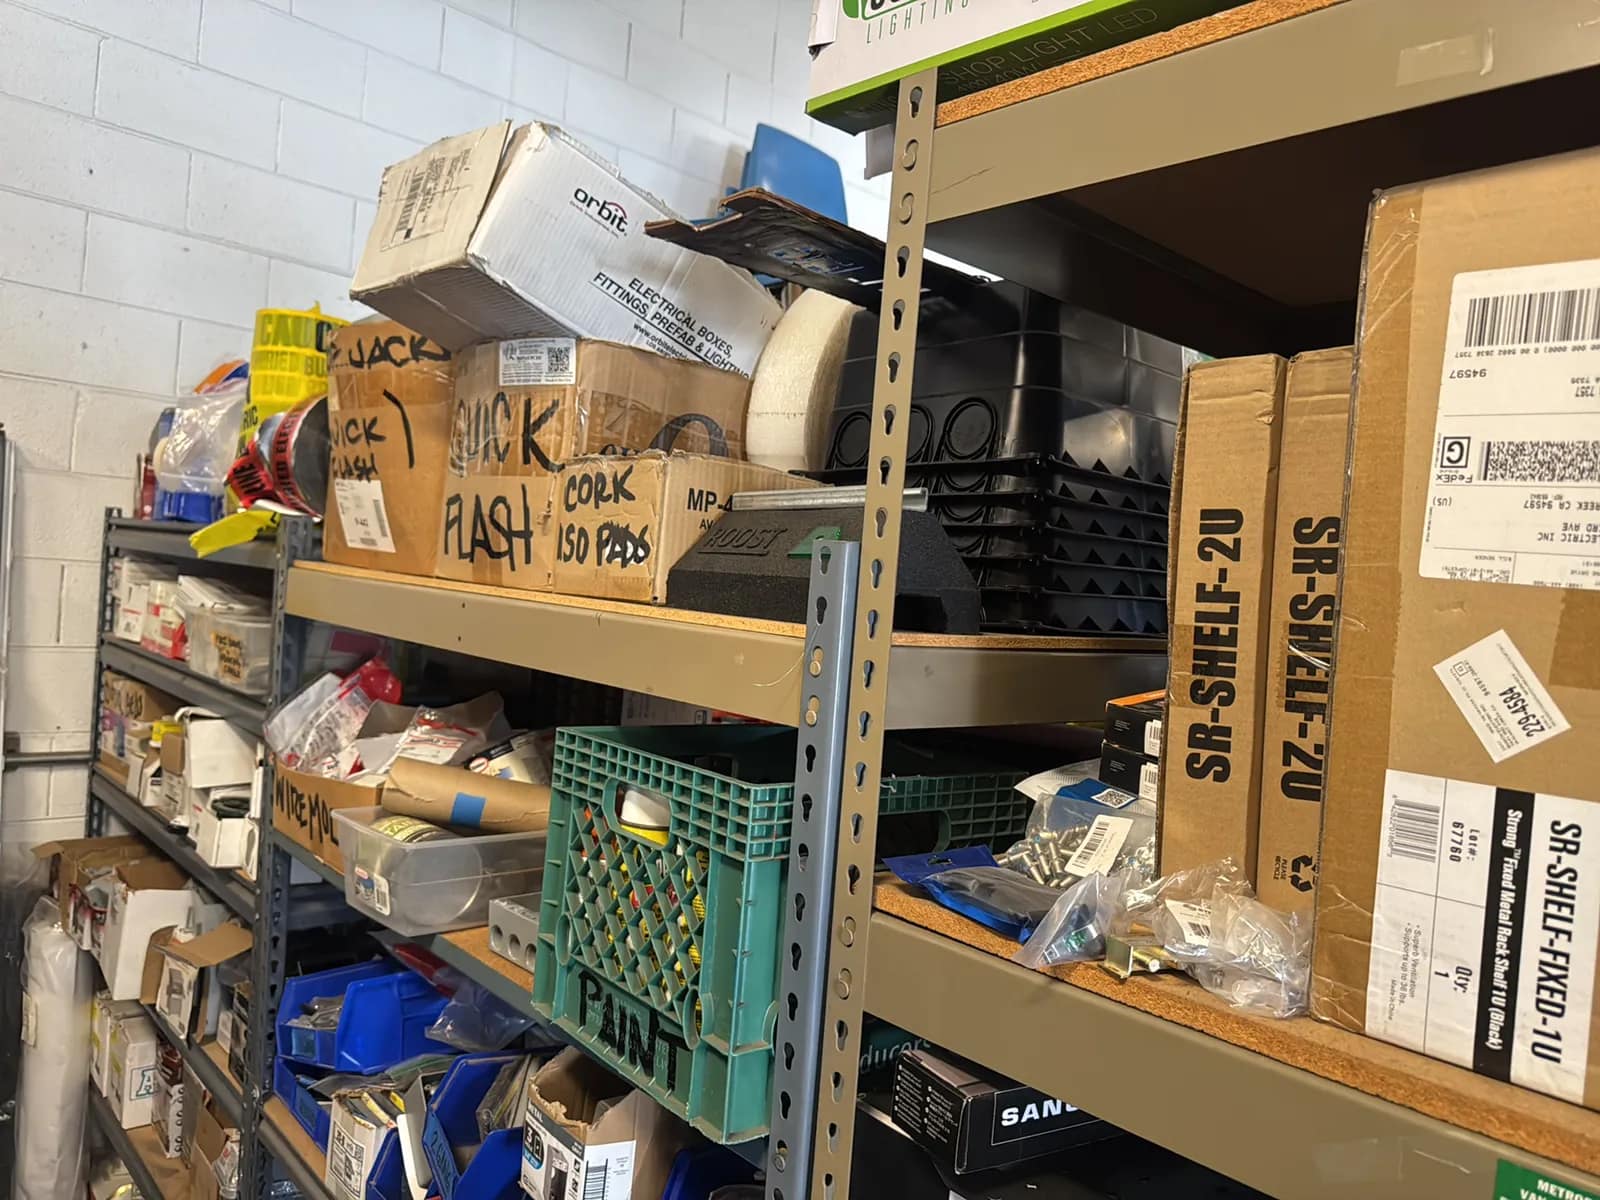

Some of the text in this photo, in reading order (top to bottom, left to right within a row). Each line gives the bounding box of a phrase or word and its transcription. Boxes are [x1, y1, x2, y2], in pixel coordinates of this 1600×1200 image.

[942, 7, 1159, 85] SHOP LIGHT LED
[574, 188, 628, 233] orbit
[593, 271, 649, 319] FITTINGS,
[650, 311, 697, 348] PREFAB
[694, 341, 705, 353] &
[628, 277, 734, 359] ELECTRICAL BOXES,
[349, 336, 452, 369] JACK
[1449, 368, 1487, 380] 94597
[449, 391, 565, 480] QUICK
[1446, 440, 1465, 465] G
[564, 466, 636, 513] CORK
[1435, 473, 1474, 484] FedEx
[1432, 496, 1452, 507] (US)
[1523, 500, 1553, 510] 94597
[444, 484, 534, 571] FLASH
[557, 524, 586, 564] ISO
[1537, 532, 1555, 542] INC
[1562, 522, 1581, 532] AVE
[1184, 508, 1244, 784] SR-SHELF-2U
[1499, 685, 1546, 738] 229-4584
[1447, 820, 1465, 863] 67760
[1500, 857, 1518, 891] Fixed
[1497, 889, 1516, 928] Metal
[1494, 927, 1513, 959] Rack
[1530, 820, 1583, 1064] SR-SHELF-FIXED-1U
[1434, 971, 1450, 979] 1
[1453, 966, 1473, 994] Qty:
[1491, 956, 1511, 988] Shelf
[1490, 985, 1509, 1009] 1U
[578, 969, 692, 1092] PAINT
[1485, 1006, 1506, 1051] (Black)
[1537, 1179, 1593, 1200] METRO
